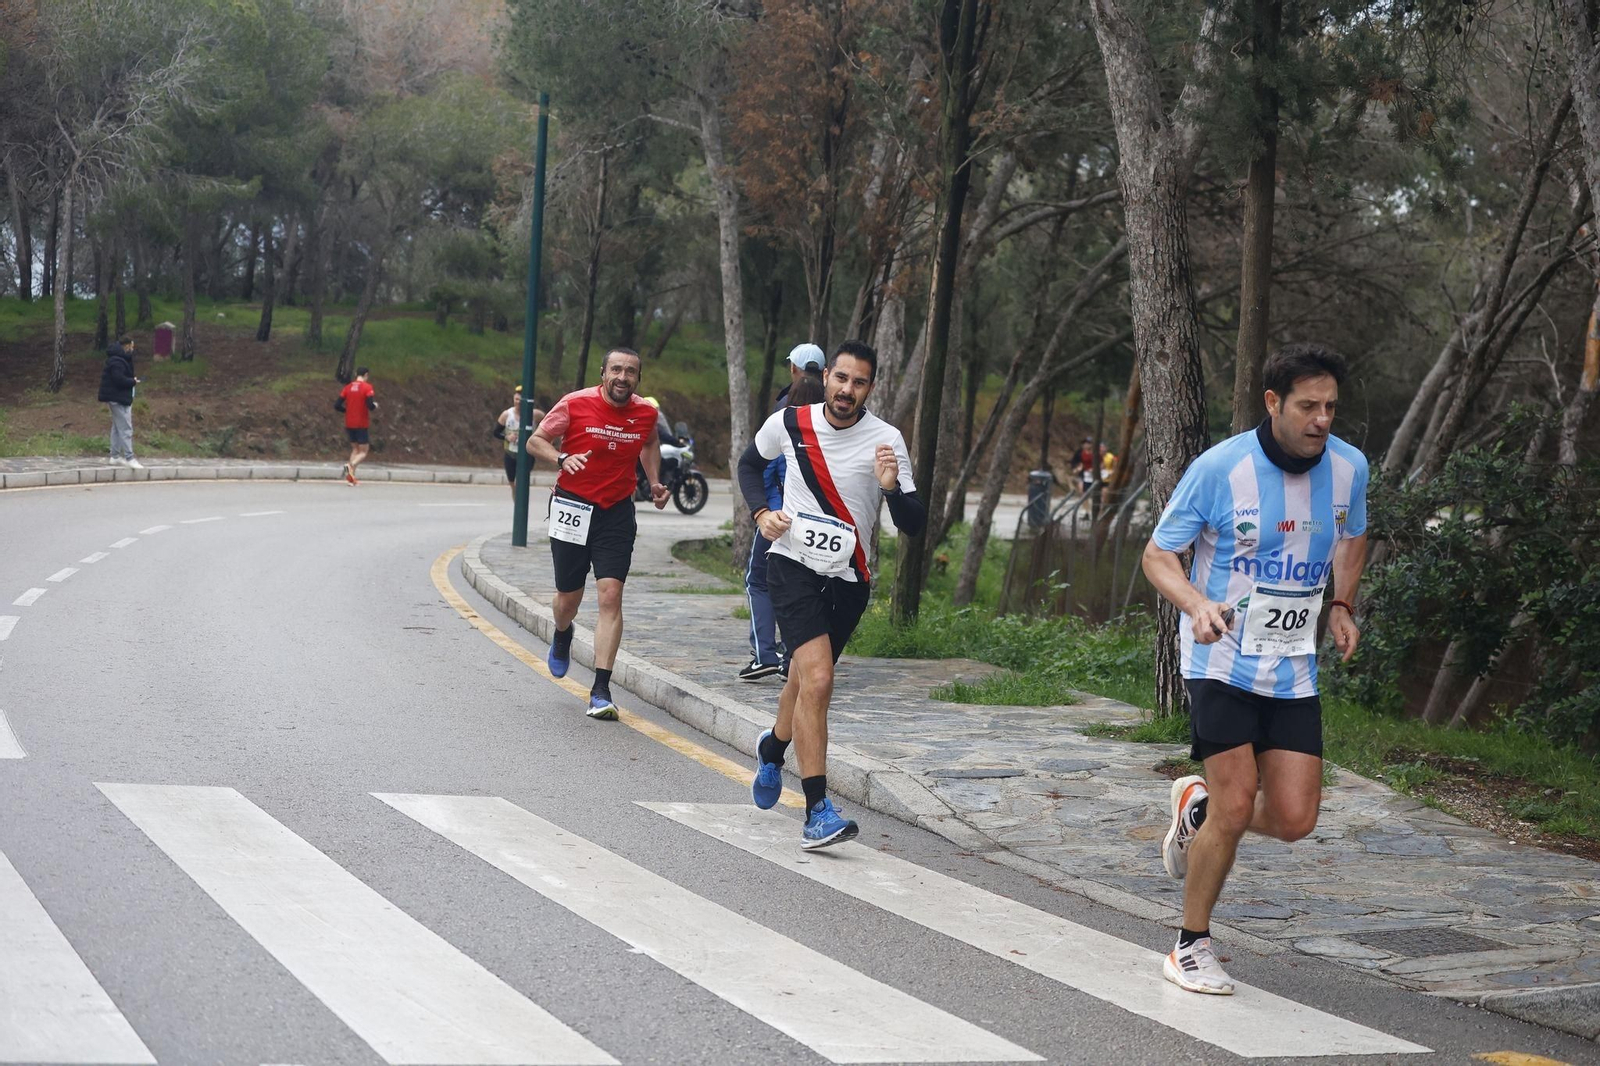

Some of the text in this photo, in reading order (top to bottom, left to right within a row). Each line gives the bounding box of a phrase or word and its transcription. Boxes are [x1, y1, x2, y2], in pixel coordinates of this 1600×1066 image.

[585, 426, 606, 435] CARRERA
[620, 432, 641, 440] EMPRESAS
[557, 511, 581, 528] 226
[1236, 508, 1259, 517] vive
[803, 529, 842, 552] 326
[1264, 608, 1310, 631] 208
